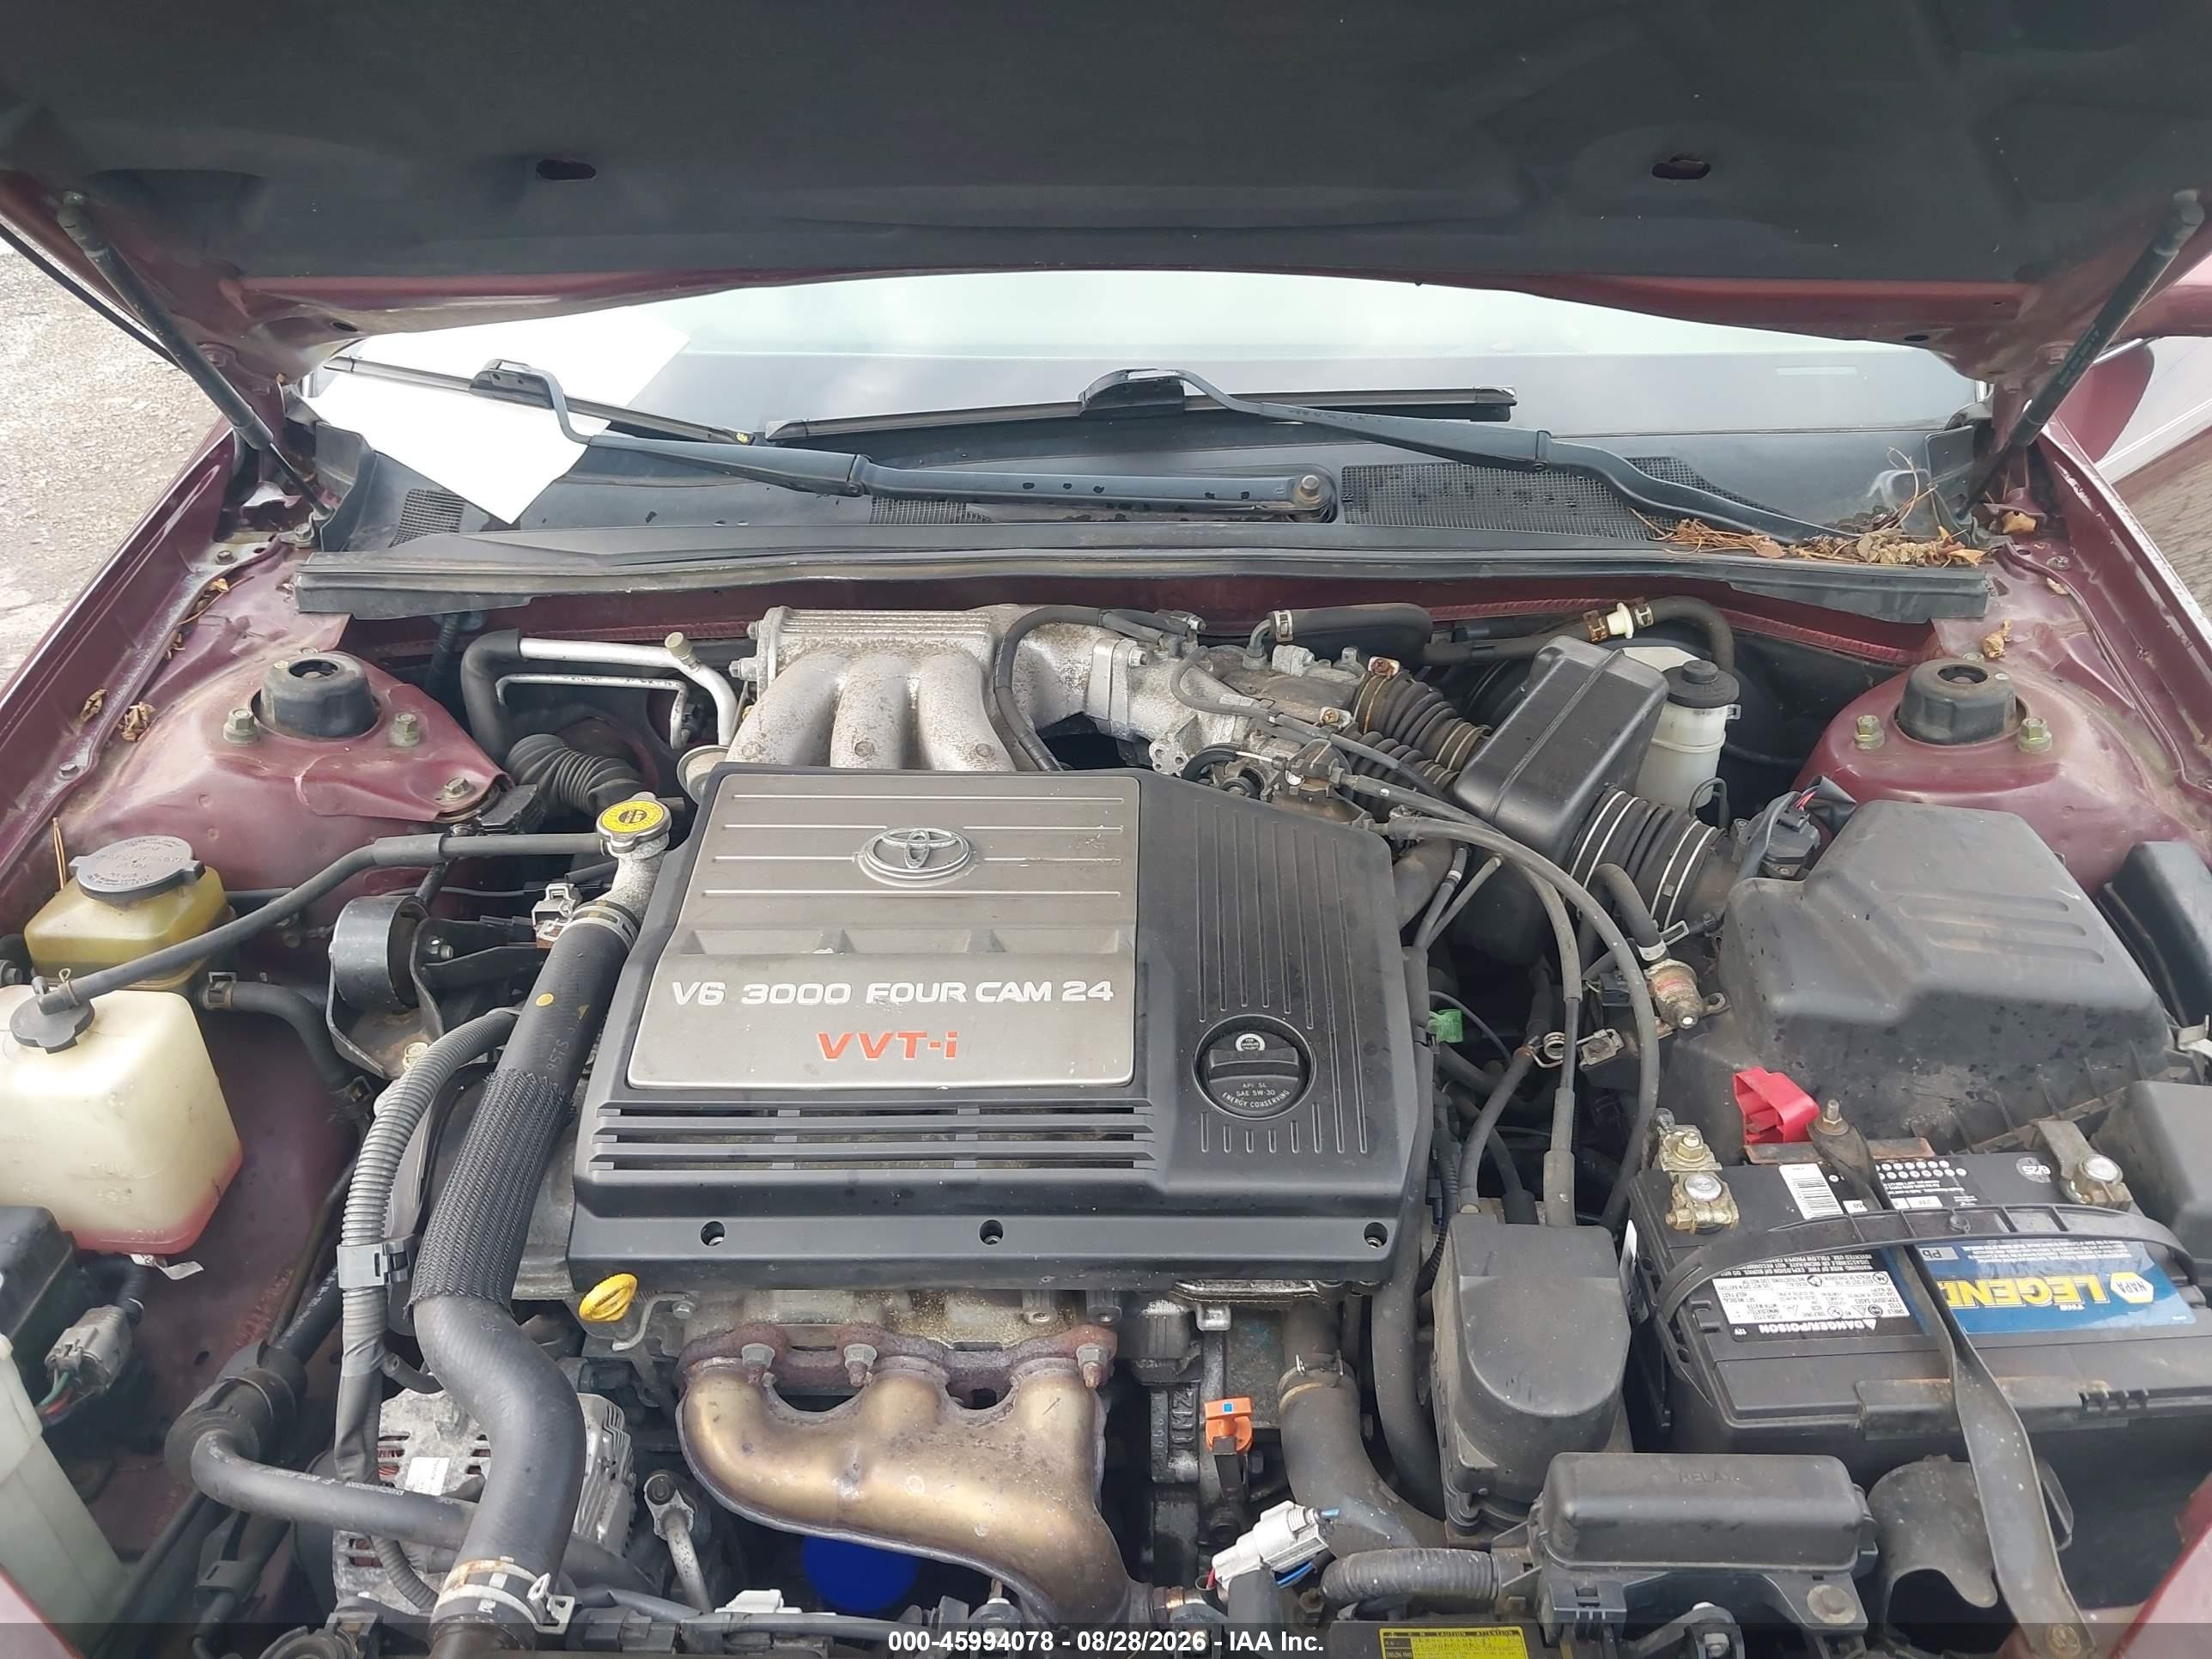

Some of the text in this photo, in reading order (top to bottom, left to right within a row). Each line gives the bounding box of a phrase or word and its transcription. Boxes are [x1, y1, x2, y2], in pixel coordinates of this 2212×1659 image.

[672, 981, 1114, 1006] V6 3000 FOUR CAM 24
[816, 1030, 959, 1061] VVT-i
[1221, 1089, 1291, 1109] ENERGY CONSERVING
[1922, 1249, 1942, 1259] Pb
[2116, 1280, 2148, 1293] NAPA
